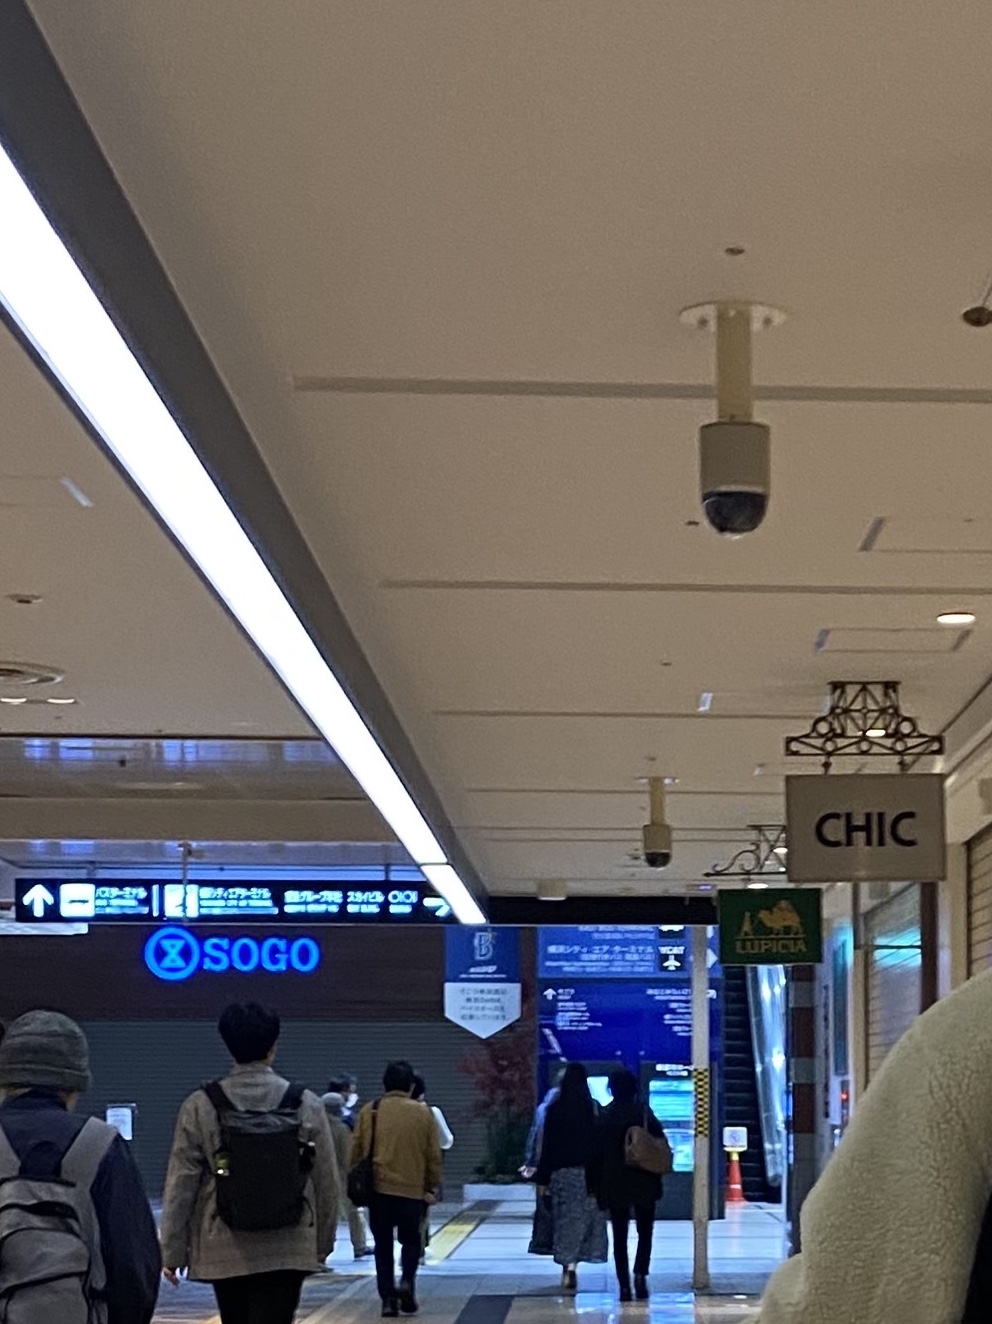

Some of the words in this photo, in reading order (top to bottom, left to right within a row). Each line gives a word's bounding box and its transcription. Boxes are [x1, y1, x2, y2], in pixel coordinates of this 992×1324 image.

[815, 811, 919, 848] CHIC
[202, 936, 321, 974] SOGO
[734, 939, 808, 954] LUPICIA
